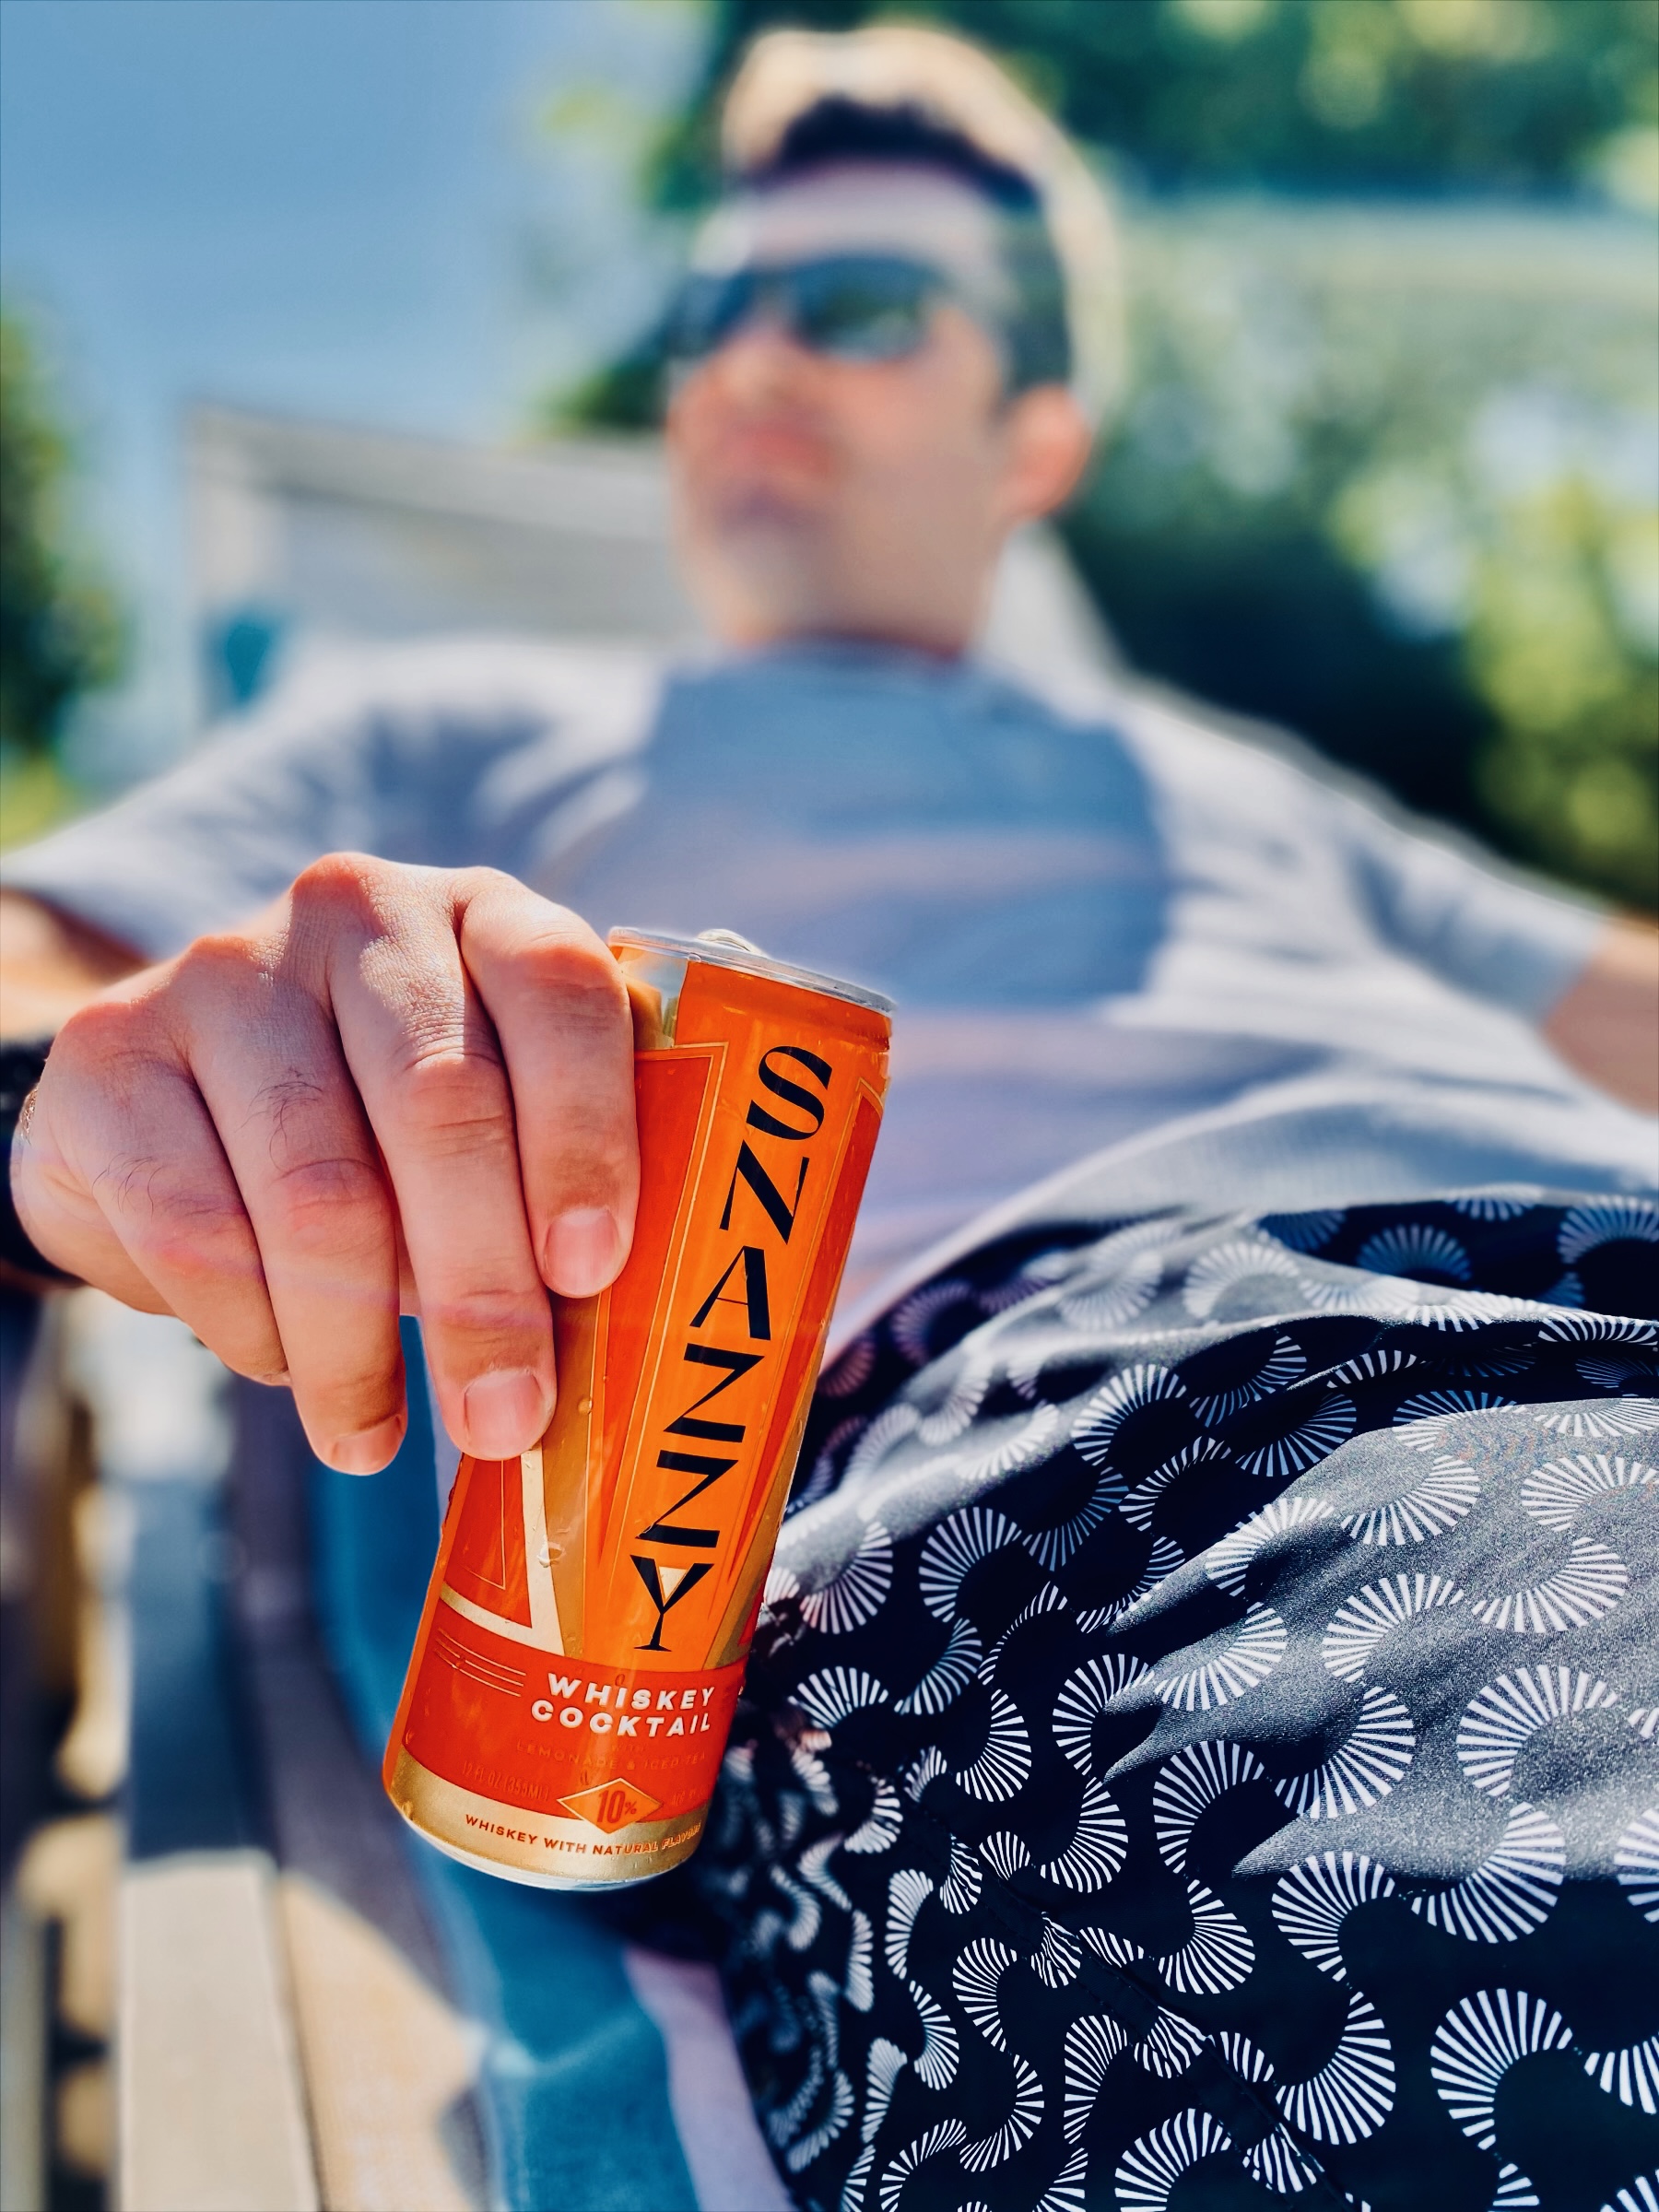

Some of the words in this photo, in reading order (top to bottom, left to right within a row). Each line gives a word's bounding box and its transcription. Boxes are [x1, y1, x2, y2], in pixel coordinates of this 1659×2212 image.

[630, 1044, 832, 1652] SNAZZY
[547, 1672, 715, 1712] WHISKEY
[531, 1700, 711, 1737] COCKTAIL
[516, 1738, 618, 1770] LEMONADE
[643, 1759, 680, 1771] ICED
[599, 1789, 637, 1824] 10%
[465, 1814, 538, 1844] WHISKEY
[544, 1838, 587, 1854] WITH
[593, 1840, 659, 1855] NATURAL
